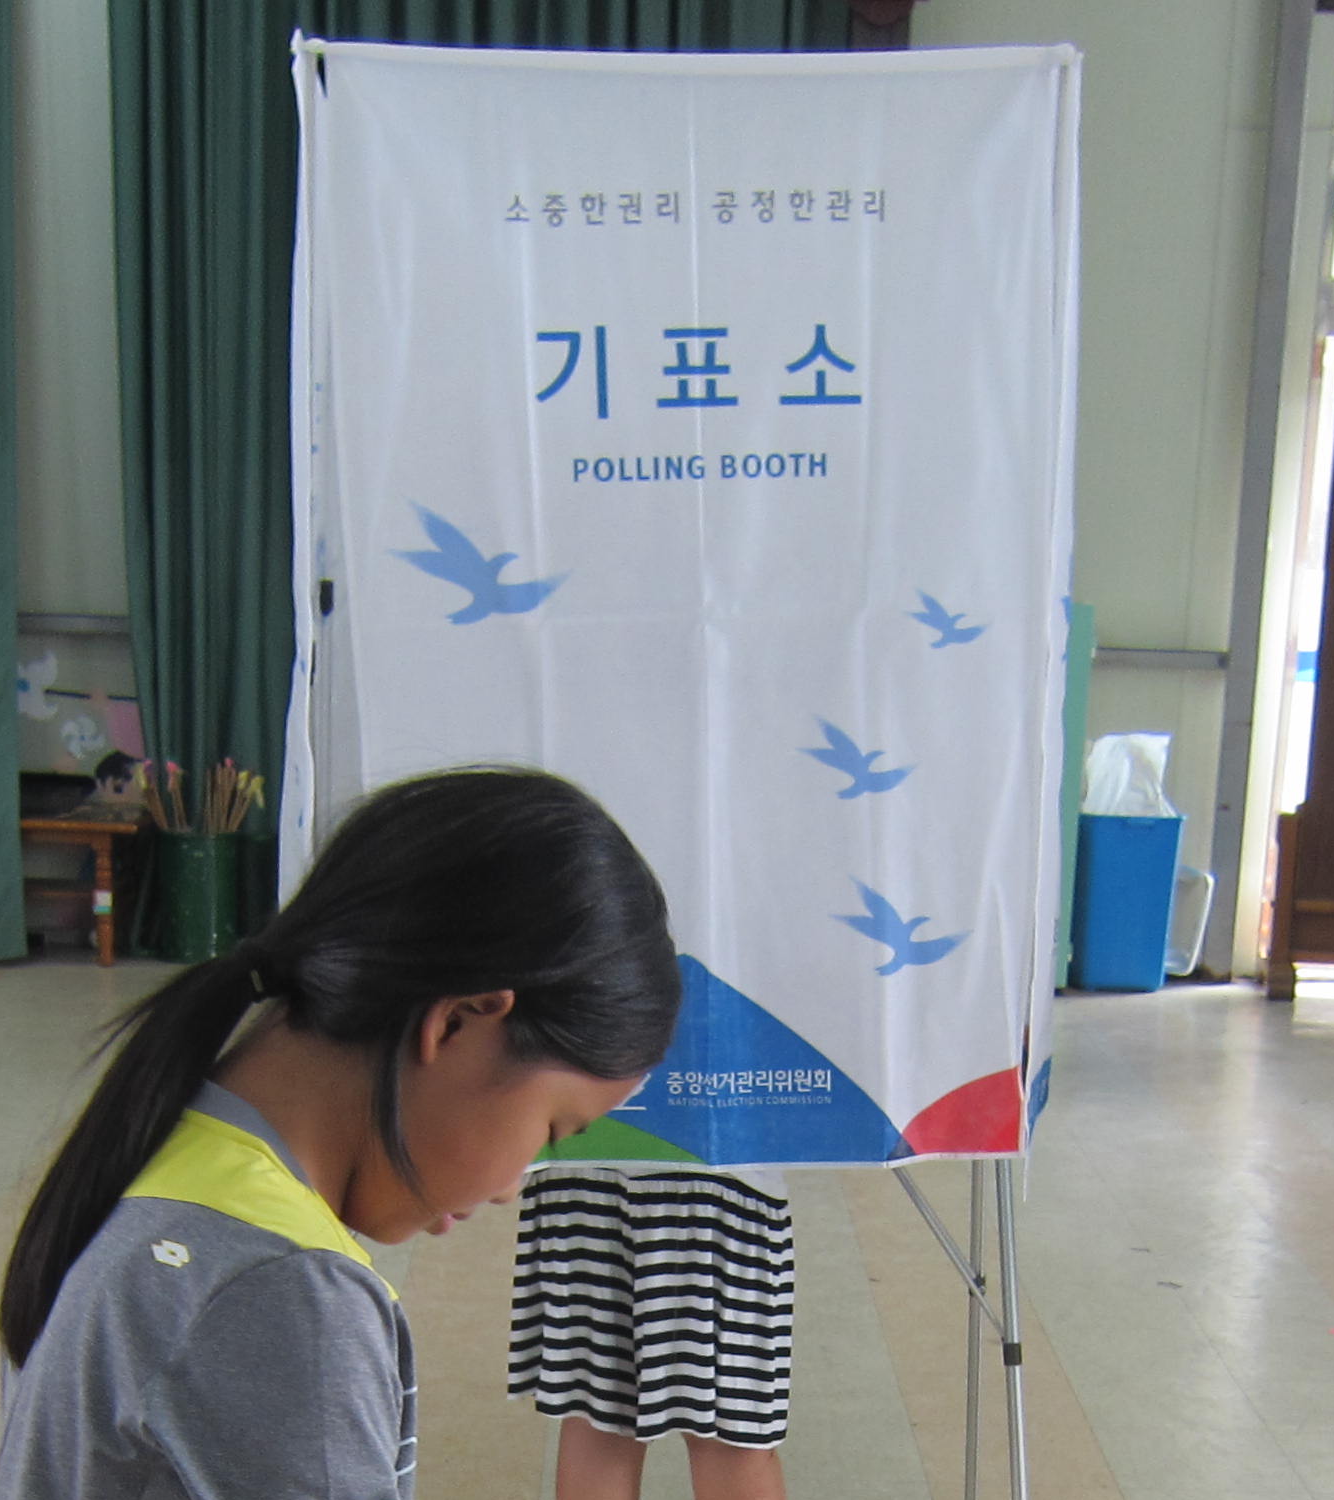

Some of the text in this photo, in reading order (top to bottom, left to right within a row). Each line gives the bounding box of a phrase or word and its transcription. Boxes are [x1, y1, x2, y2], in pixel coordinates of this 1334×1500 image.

[504, 189, 887, 228] 소중한권리 공정한관리
[535, 323, 863, 420] 기표소
[573, 452, 829, 482] POLLING BOOTH
[666, 1069, 832, 1095] 중앙선거관리위원회
